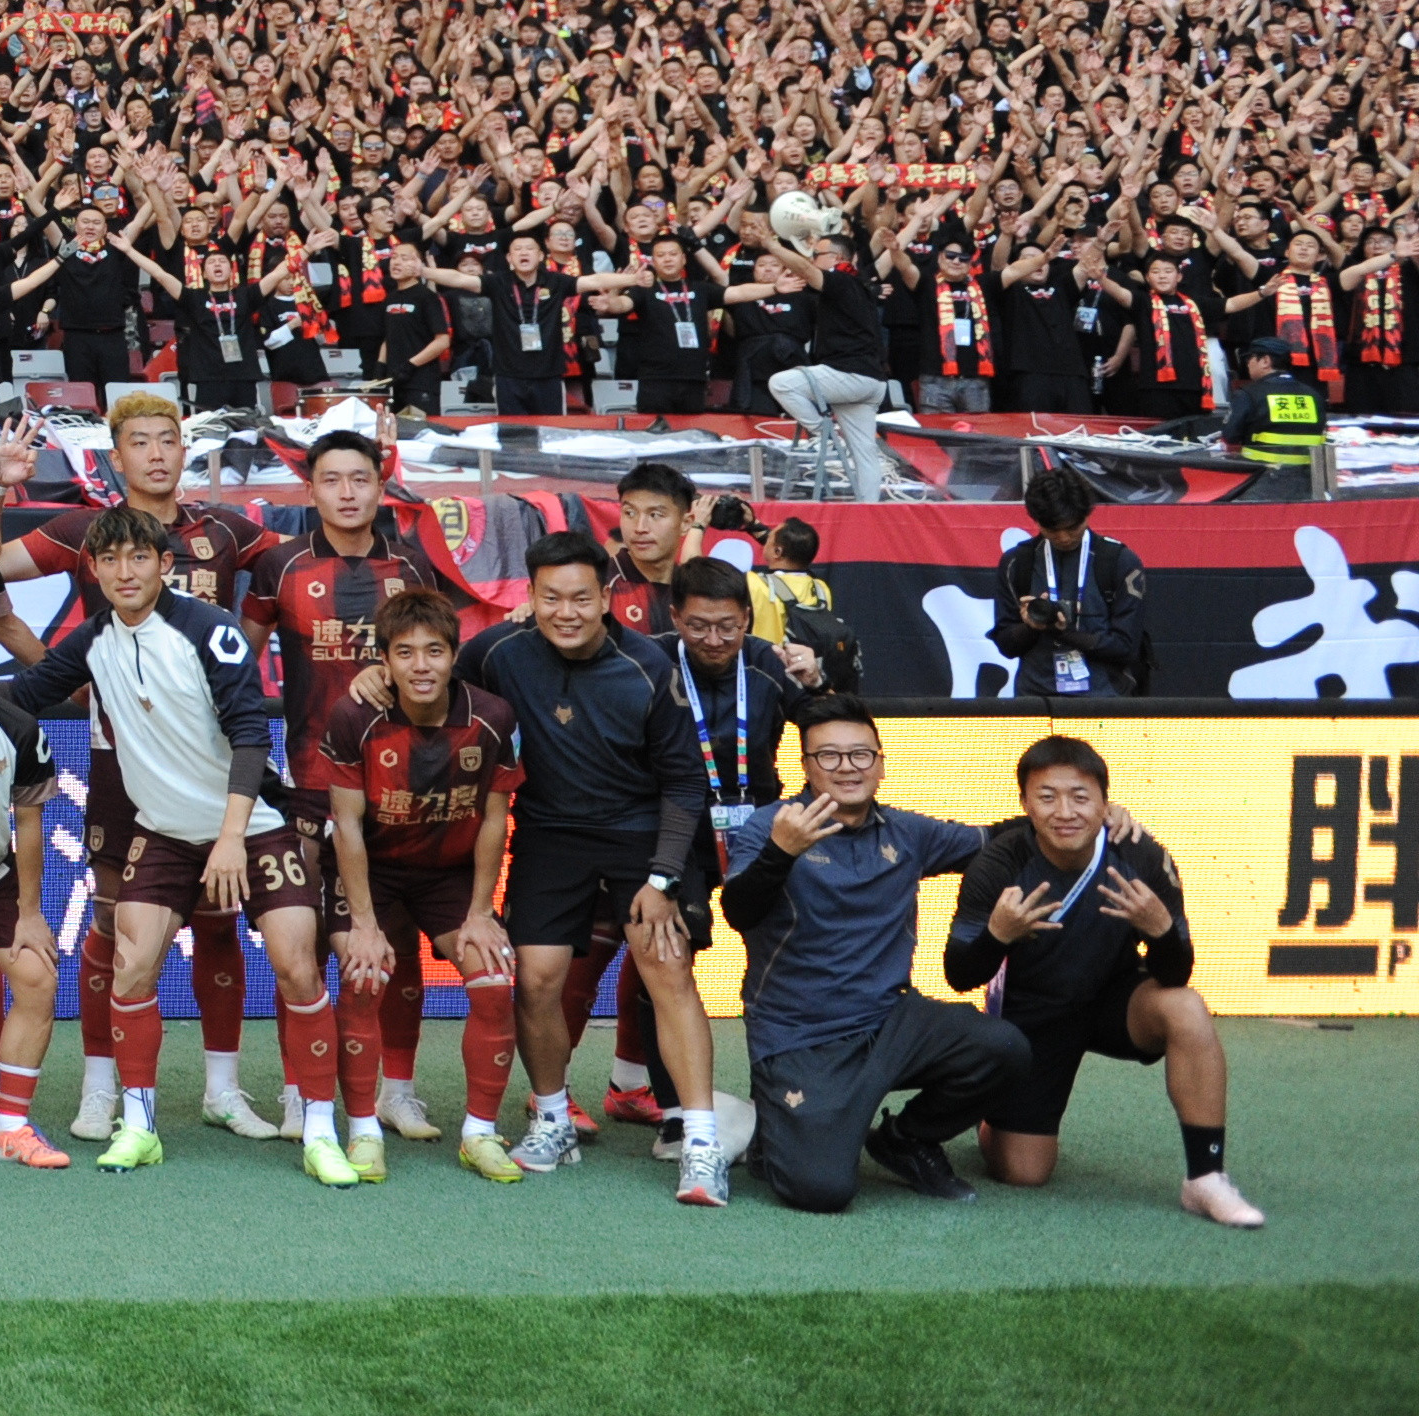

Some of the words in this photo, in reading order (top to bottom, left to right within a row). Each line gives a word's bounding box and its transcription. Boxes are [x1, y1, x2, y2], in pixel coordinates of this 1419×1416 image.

[1274, 396, 1308, 411] 安保
[1292, 412, 1311, 420] BAO
[380, 784, 478, 815] 速力奥
[258, 850, 306, 891] 36
